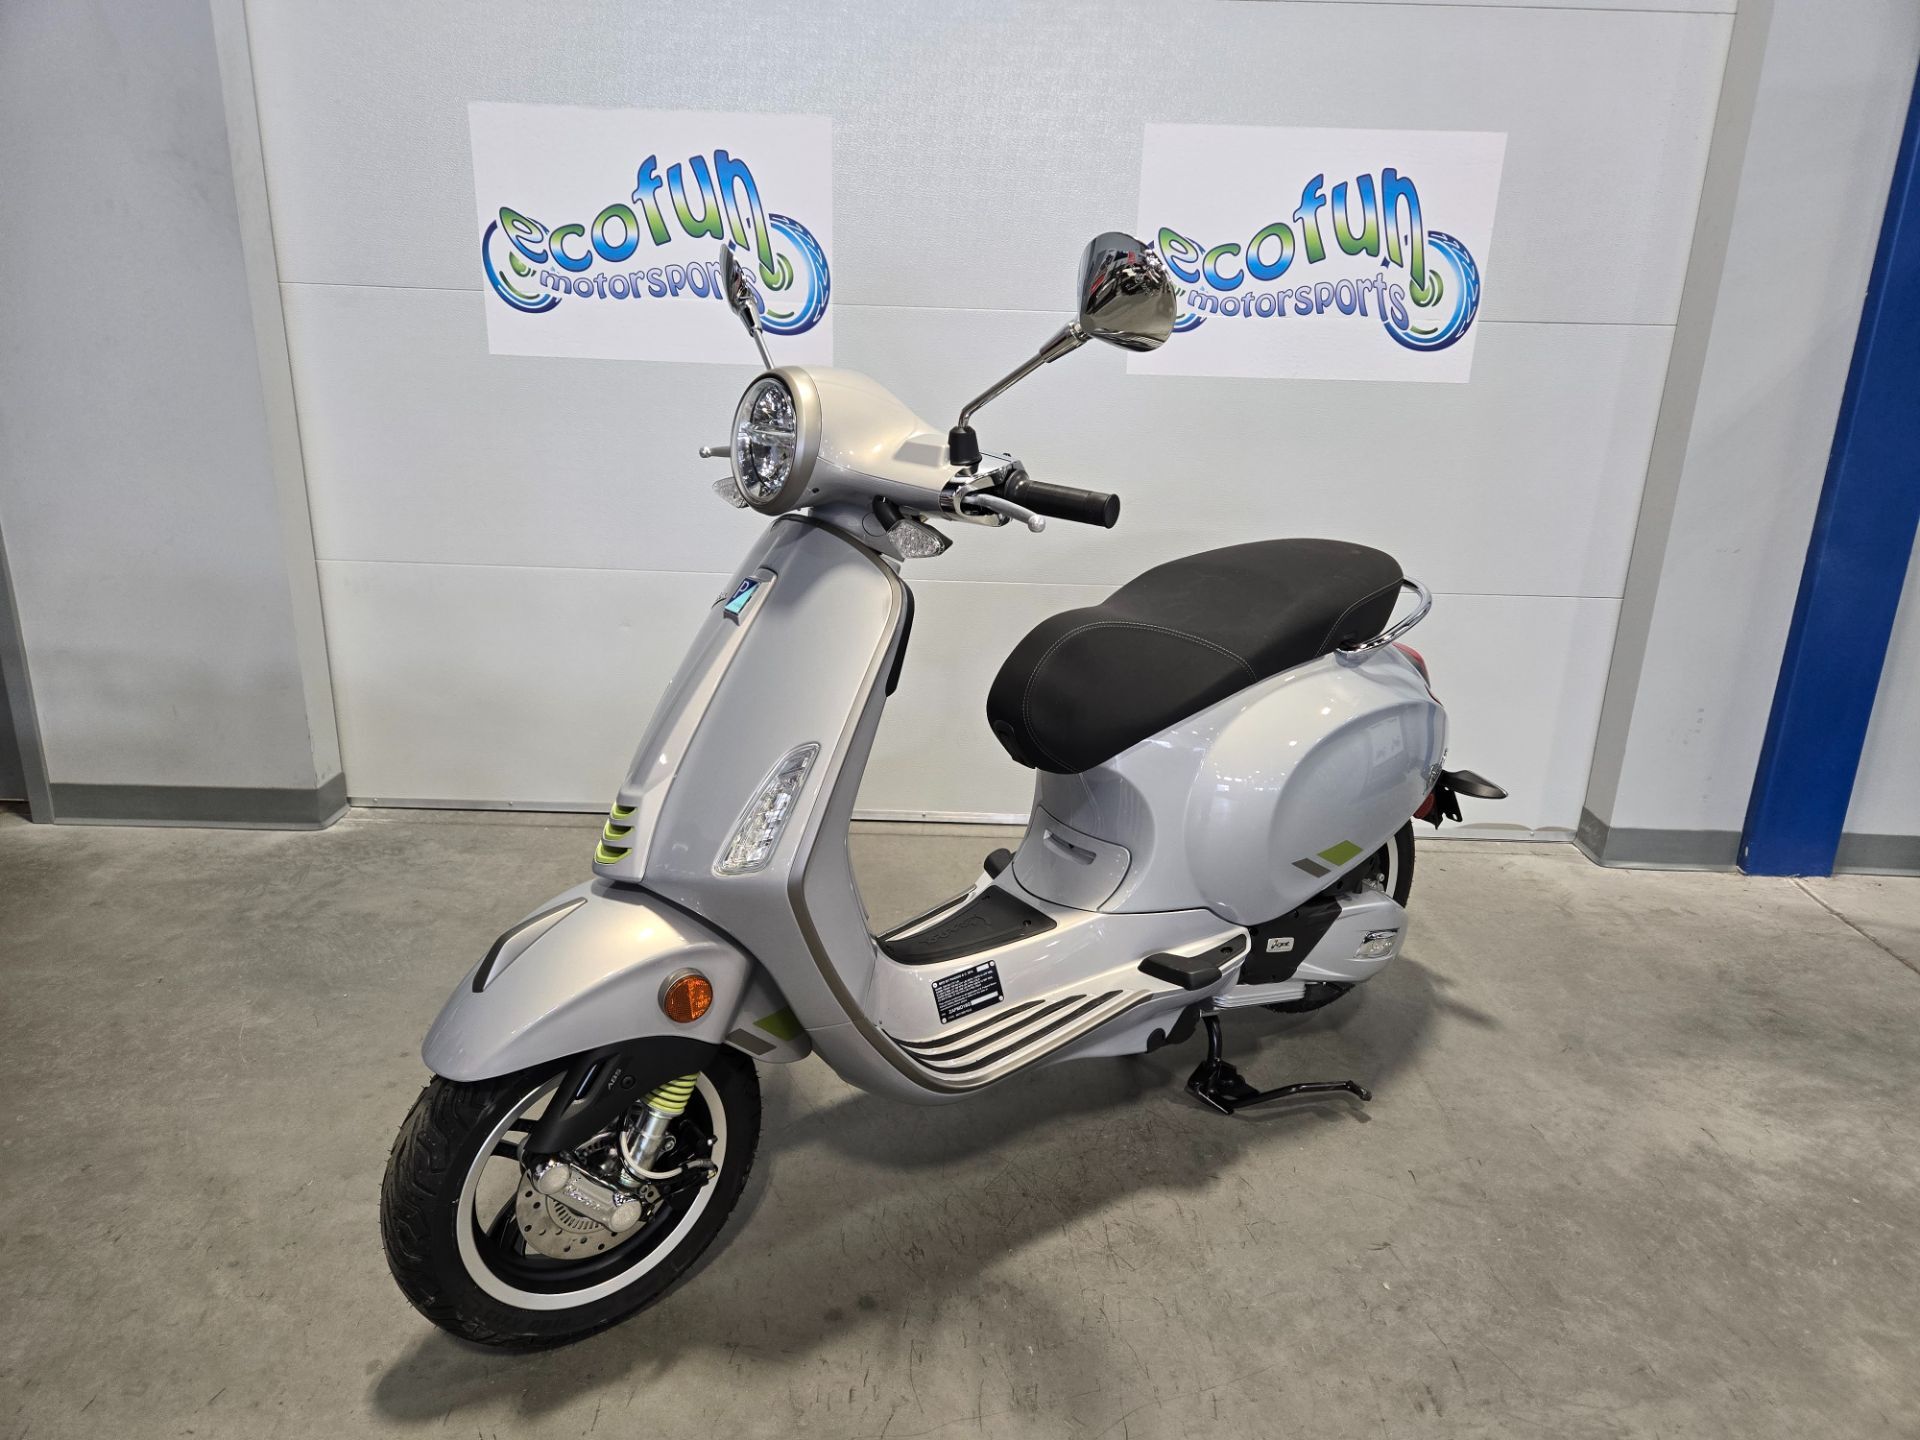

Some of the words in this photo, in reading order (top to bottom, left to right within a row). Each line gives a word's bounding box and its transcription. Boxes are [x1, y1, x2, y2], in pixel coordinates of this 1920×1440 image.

[499, 149, 774, 276] ecofun
[1158, 168, 1424, 292] ecofun
[541, 261, 765, 315] motorspors
[1188, 273, 1410, 331] motorsports
